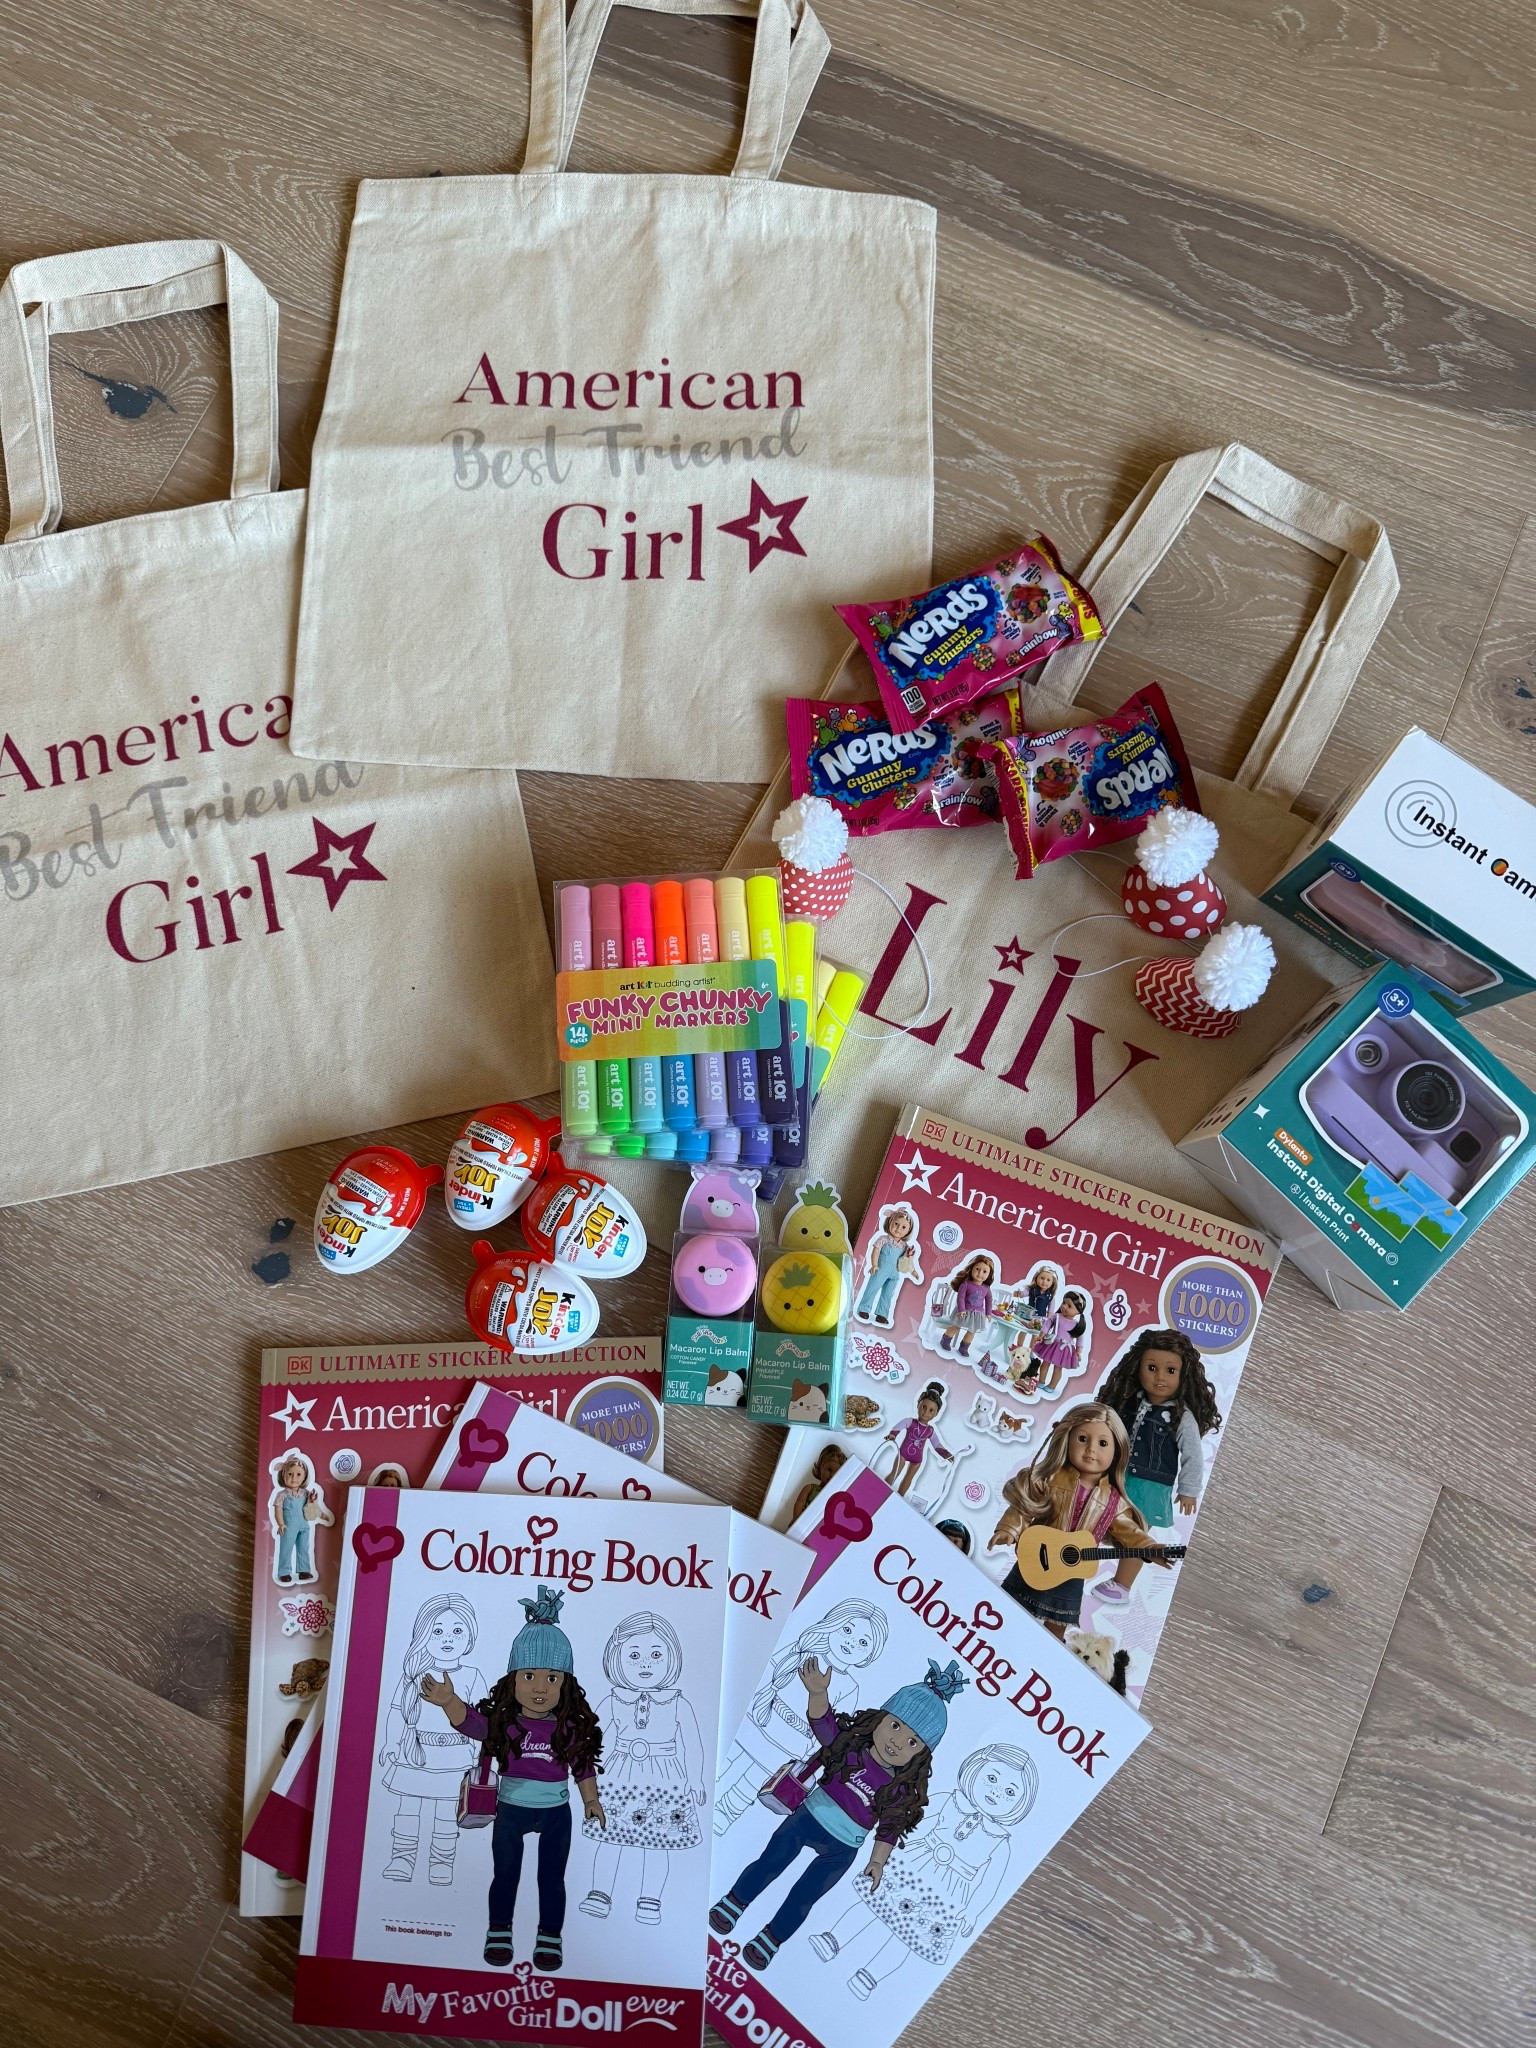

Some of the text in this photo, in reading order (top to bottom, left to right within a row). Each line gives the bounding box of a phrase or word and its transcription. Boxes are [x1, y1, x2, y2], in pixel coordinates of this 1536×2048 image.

[452, 352, 805, 412] American
[441, 405, 808, 491] Best Friend
[542, 503, 705, 581] Girl
[923, 625, 968, 665] Gummy
[938, 627, 983, 666] Clusters
[1019, 628, 1058, 657] rainbow
[902, 687, 921, 704] 100
[0, 695, 293, 797] America
[1107, 731, 1147, 760] Clusters
[1119, 735, 1156, 762] Gummy
[847, 760, 902, 789] Gummy
[861, 767, 916, 794] Clusters
[939, 793, 983, 809] rainbow
[0, 761, 365, 901] Best Friend
[1413, 805, 1536, 901] Instant Cam
[105, 852, 286, 963] Girl
[573, 940, 584, 961] art
[606, 939, 618, 960] art
[636, 937, 647, 957] art
[669, 936, 680, 956] art
[701, 933, 712, 954] art
[731, 930, 742, 950] art
[654, 979, 691, 989] budding
[567, 987, 772, 1024] FUNKY CHUNKY
[858, 882, 1160, 1150] Lily
[1389, 994, 1405, 1009] 3+
[570, 1027, 587, 1038] 14
[592, 1010, 750, 1035] MINI MARKERS
[577, 1065, 590, 1110] art 101
[610, 1063, 624, 1107] art 101
[643, 1062, 657, 1106] art 101
[675, 1060, 689, 1105] art 101
[709, 1056, 723, 1100] art 101
[742, 1057, 756, 1101] art 101
[772, 1055, 787, 1100] art 101
[465, 1129, 495, 1145] WARNING:
[926, 1122, 945, 1138] DK
[1279, 1131, 1309, 1161] Dylanto
[338, 1177, 371, 1198] WARNING:
[453, 1165, 500, 1193] JOY
[952, 1130, 1267, 1258] ULTIMATE STICKER COLLECTION
[1266, 1139, 1386, 1257] Instant Digital Camera
[322, 1216, 368, 1244] JOY
[545, 1200, 567, 1236] WARNING:
[582, 1201, 615, 1250] JOY
[937, 1172, 1168, 1281] American Girl
[1303, 1196, 1349, 1242] Instant Print
[1181, 1281, 1244, 1299] MORE THAN
[495, 1300, 508, 1334] WARNING:
[531, 1286, 558, 1336] JOY
[1173, 1289, 1246, 1327] 1000
[1178, 1317, 1239, 1338] STICKERS!
[319, 1352, 420, 1373] ULTIMATE
[427, 1348, 513, 1369] STICKER
[670, 1344, 747, 1356] Macaron Lip Balm
[756, 1358, 829, 1371] Macaron Lip Balm
[290, 1359, 310, 1372] DK
[667, 1380, 689, 1389] NET WT.
[667, 1390, 679, 1398] 0.24
[691, 1391, 696, 1400] (7
[697, 1393, 703, 1401] g)
[752, 1395, 763, 1404] NET
[582, 1401, 641, 1421] MORE THAN
[751, 1405, 764, 1413] 0.24
[774, 1406, 780, 1416] (7
[781, 1407, 786, 1417] g)
[420, 1527, 713, 1593] Coloring Book
[729, 1570, 782, 1620] ok
[873, 1543, 1111, 1780] Coloring Book
[416, 1928, 443, 1937] belongs
[707, 1954, 748, 1988] rite
[381, 1977, 556, 2024] My Favorite
[508, 1995, 686, 2032] Girl Doll ever
[706, 1972, 790, 2048] irl Doll
